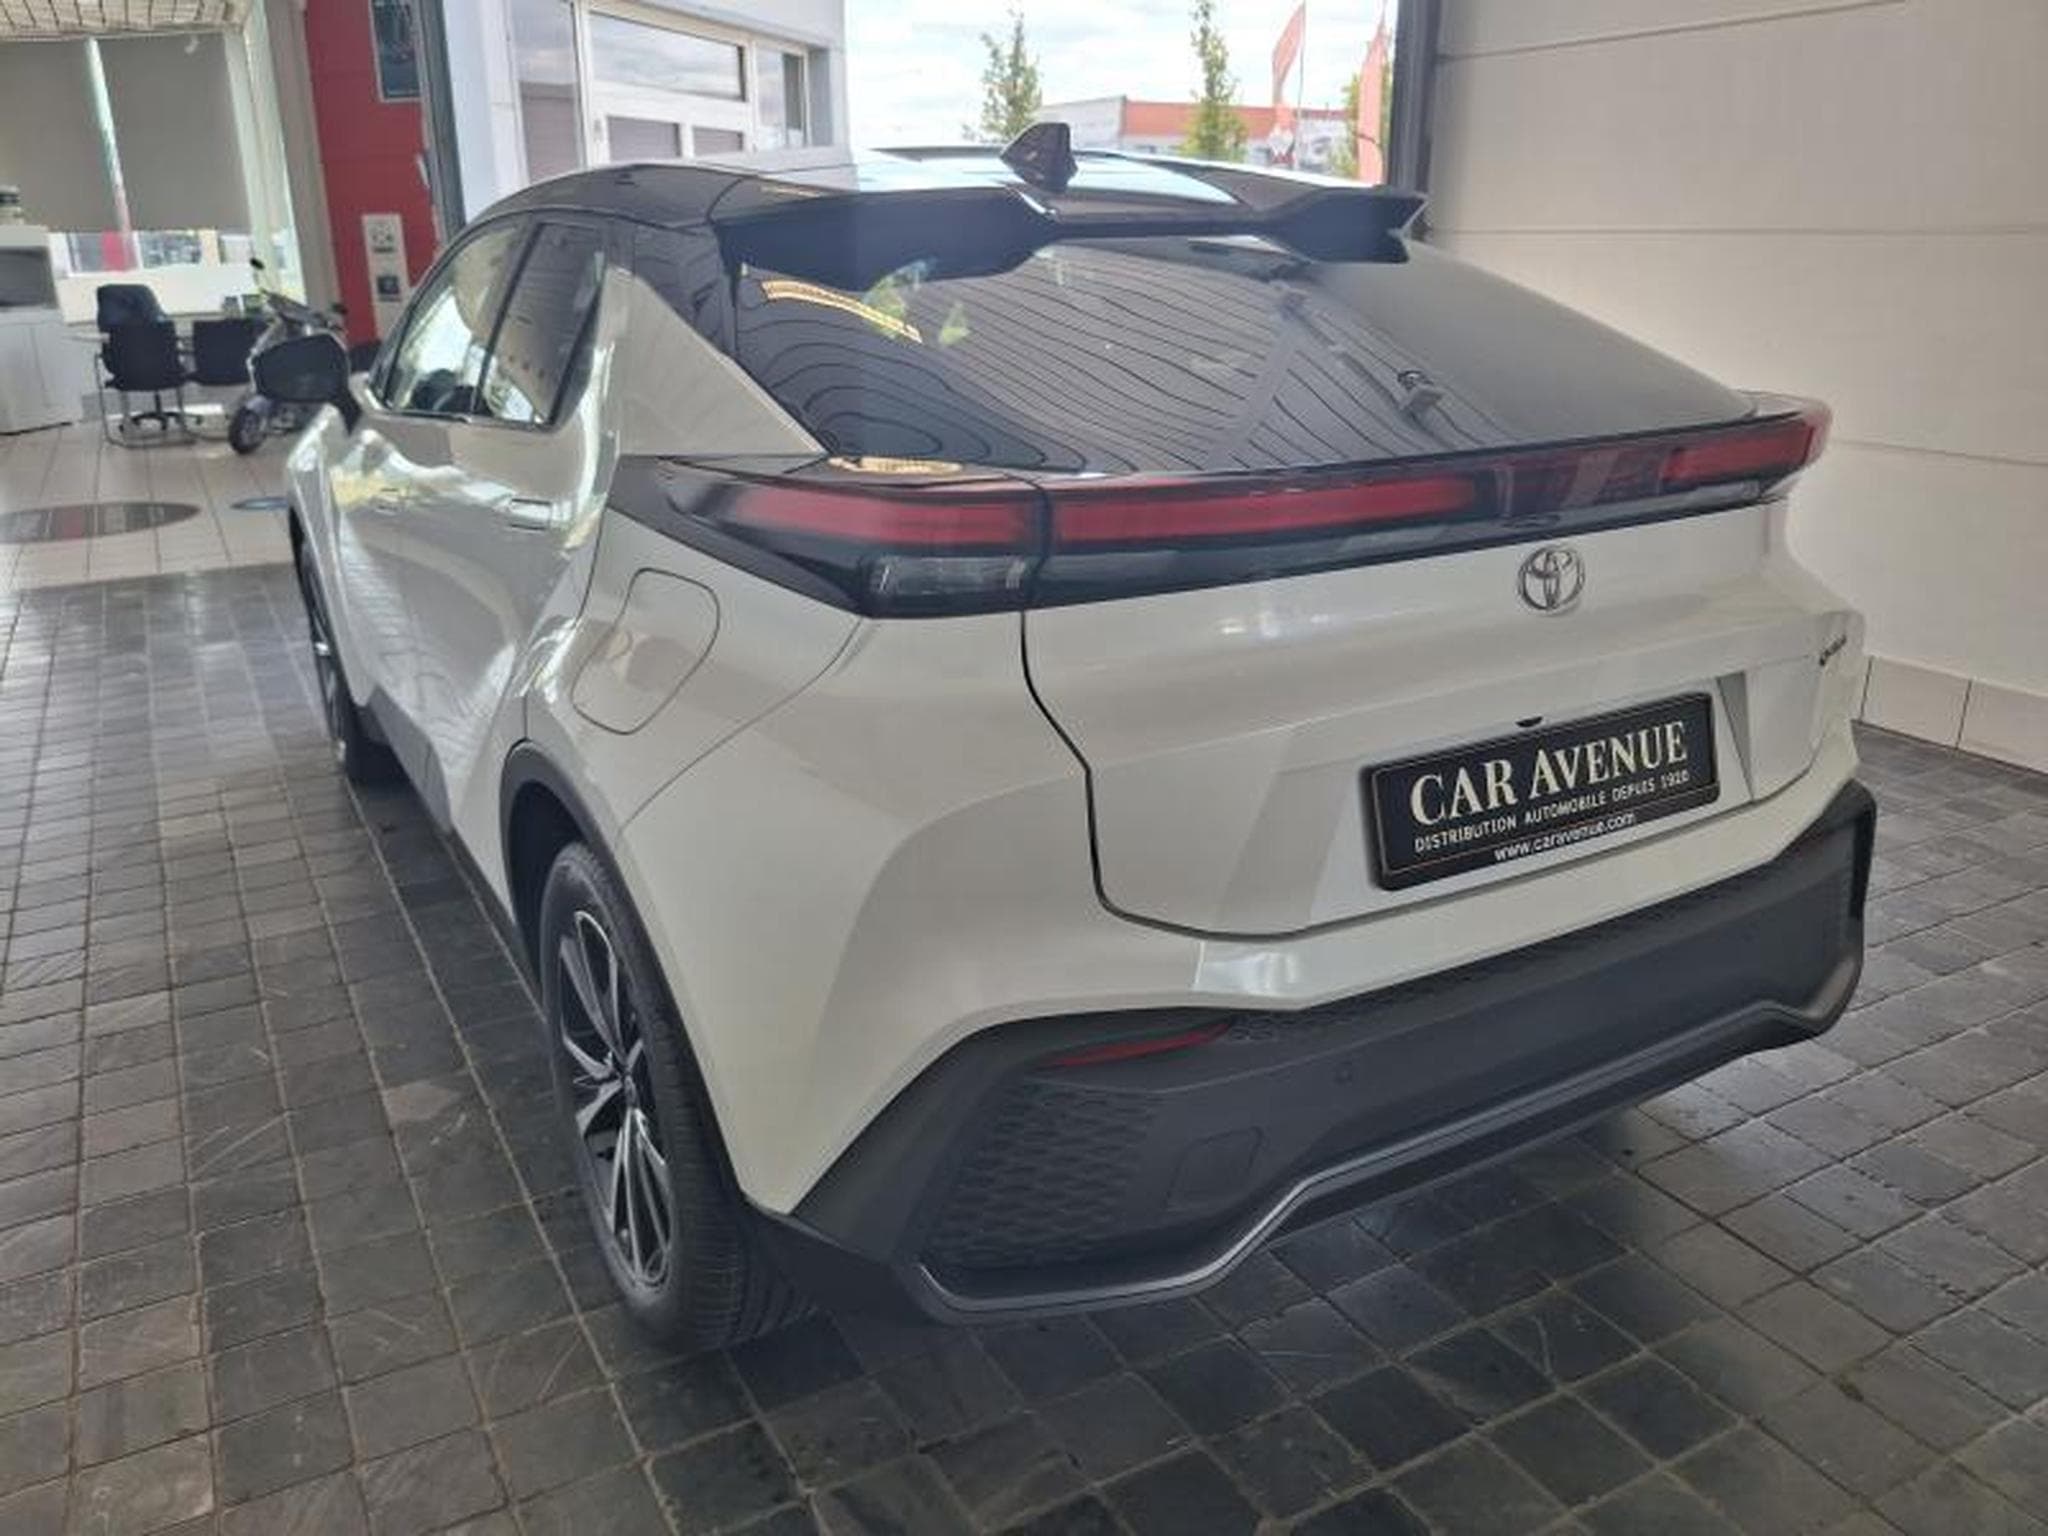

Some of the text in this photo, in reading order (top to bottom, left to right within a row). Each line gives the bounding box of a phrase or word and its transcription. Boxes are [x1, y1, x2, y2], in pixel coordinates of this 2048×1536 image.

[1410, 720, 1688, 826] CAR AVENUE
[1414, 814, 1517, 854] DISTRIBUTION
[1525, 789, 1606, 824] AUTOMOBILE
[1612, 777, 1655, 802] DEPUIS
